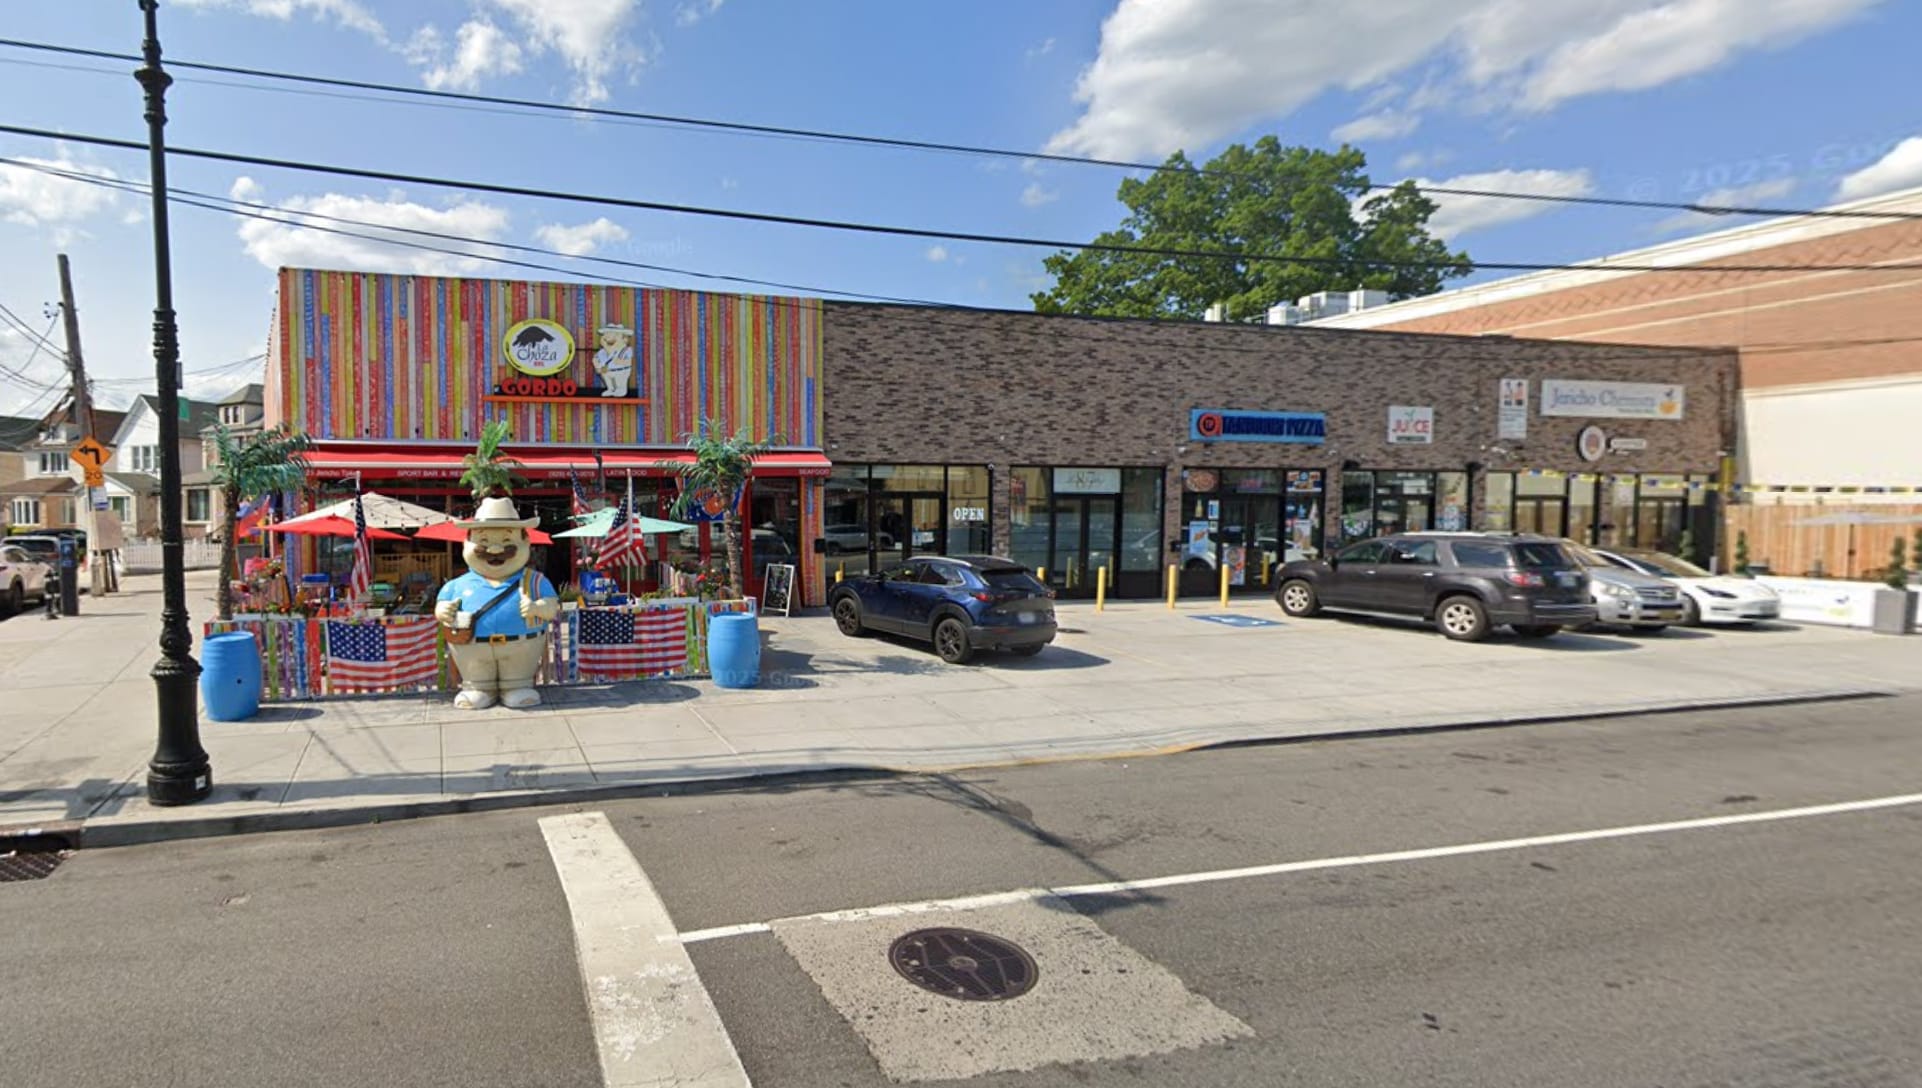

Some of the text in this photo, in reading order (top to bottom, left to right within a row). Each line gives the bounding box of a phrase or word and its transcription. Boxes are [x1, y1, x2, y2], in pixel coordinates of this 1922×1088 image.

[517, 345, 557, 361] Choza
[501, 377, 577, 396] GORDO
[1549, 387, 1597, 409] Jericho
[1286, 418, 1325, 436] PIZZA
[397, 469, 421, 478] SPORT
[423, 470, 438, 478] BAR
[606, 469, 625, 477] LATIN
[953, 507, 985, 521] OPEN
